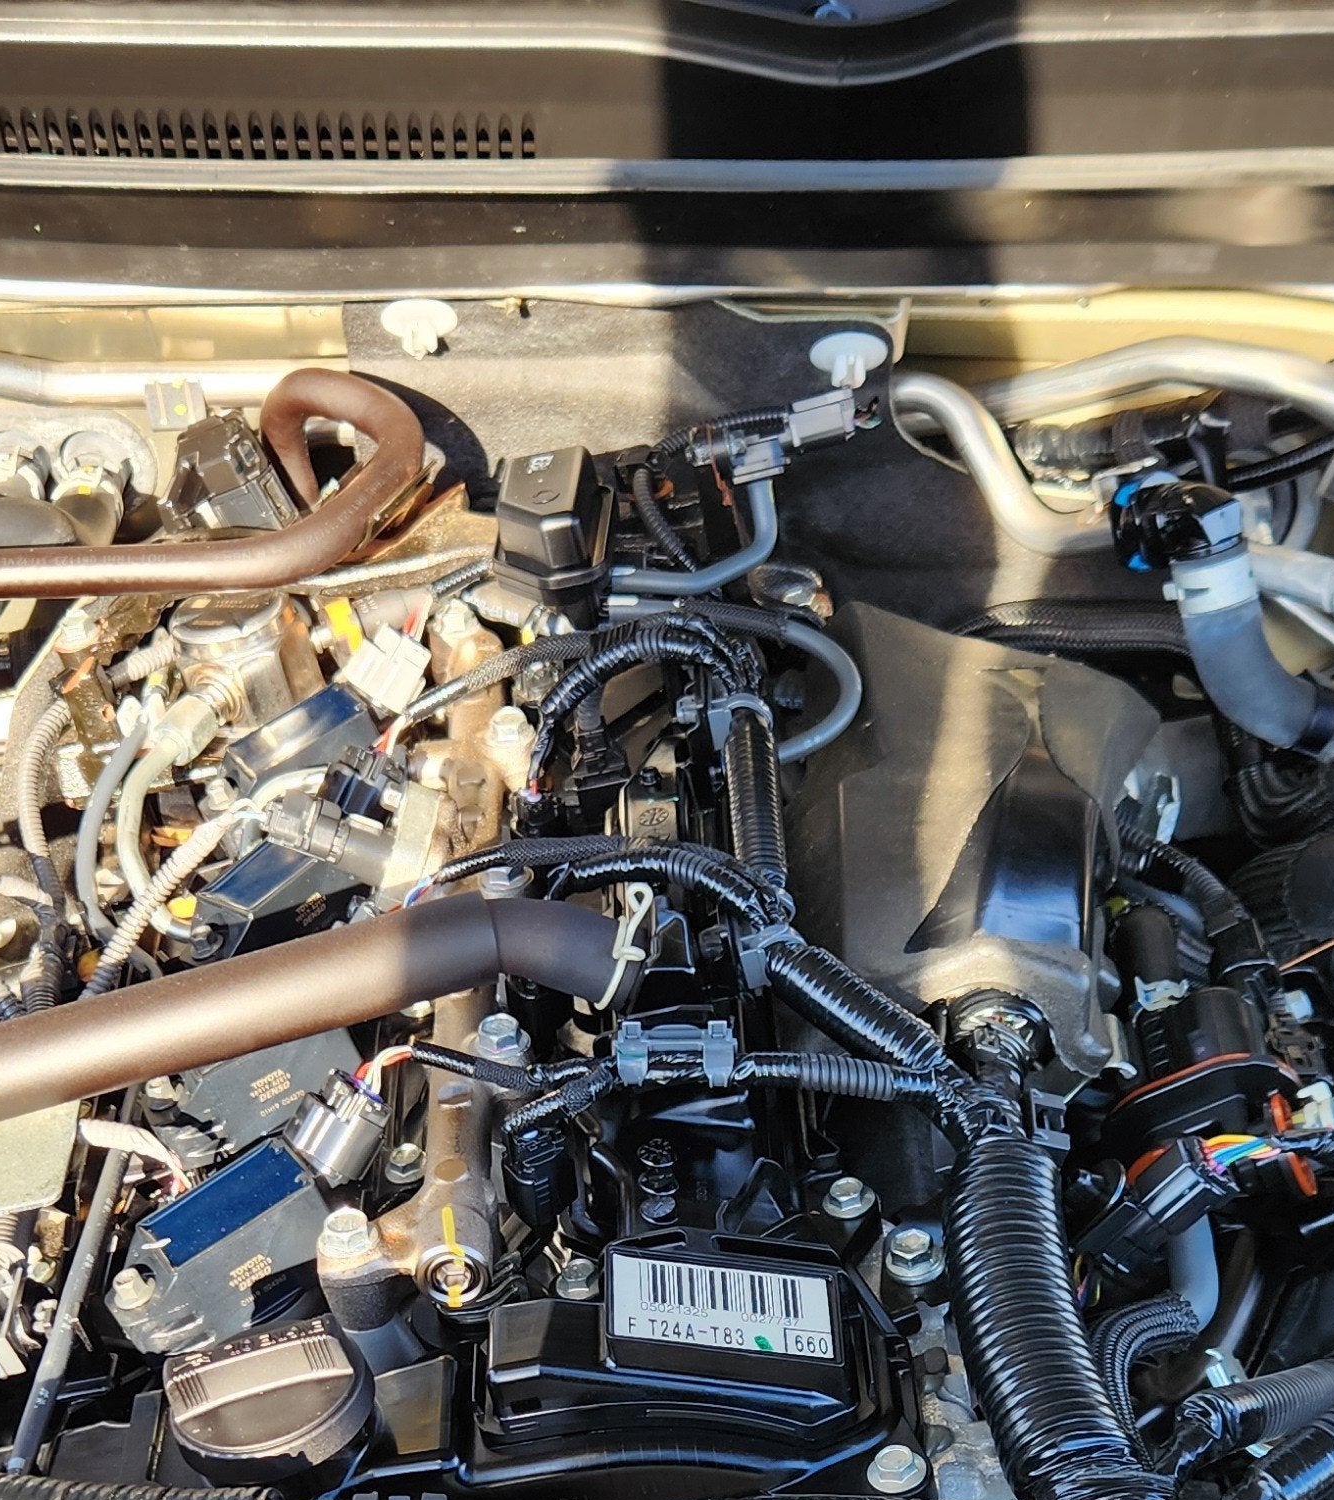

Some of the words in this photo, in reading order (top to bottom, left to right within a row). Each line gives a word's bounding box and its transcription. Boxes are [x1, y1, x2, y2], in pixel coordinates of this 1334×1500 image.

[251, 1068, 285, 1089] TOYOTA
[259, 1080, 290, 1103] DENSO
[230, 1254, 266, 1278] TOYOTA
[238, 1265, 272, 1292] DENSO
[640, 1301, 709, 1318] 05021325
[628, 1317, 637, 1333] F
[648, 1318, 745, 1346] T24A-T83
[795, 1335, 829, 1355] 660
